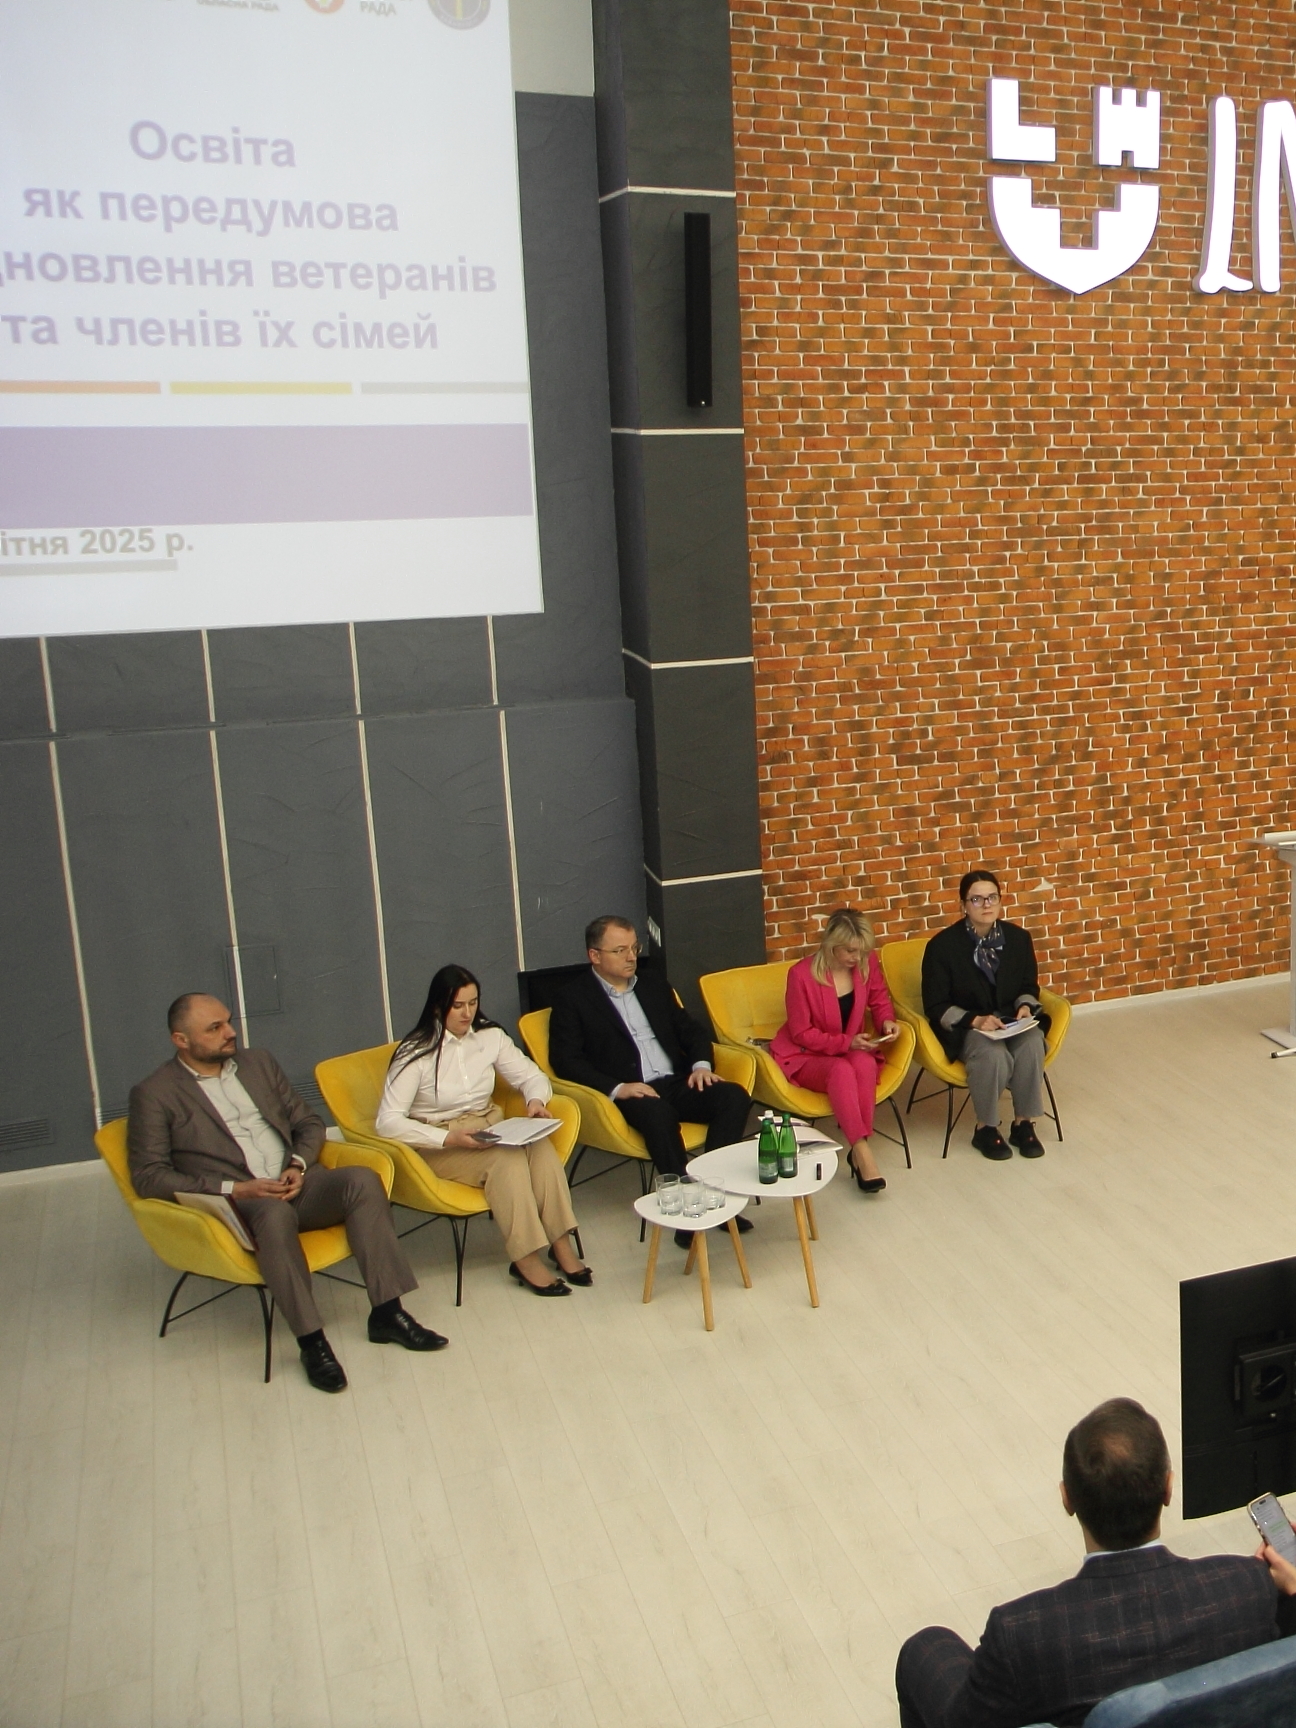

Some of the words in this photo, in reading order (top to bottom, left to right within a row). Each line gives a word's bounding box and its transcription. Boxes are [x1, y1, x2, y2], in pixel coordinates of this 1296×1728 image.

[360, 1, 397, 16] РАДА
[129, 120, 296, 167] Освіта
[23, 188, 83, 220] як
[100, 190, 398, 237] передумова
[0, 251, 254, 287] новлення
[271, 255, 497, 299] ветеранів
[1, 314, 59, 345] та
[75, 309, 242, 347] членів
[252, 310, 298, 348] їх
[312, 312, 438, 349] сімей
[79, 527, 156, 554] 2025
[165, 532, 194, 557] р.
